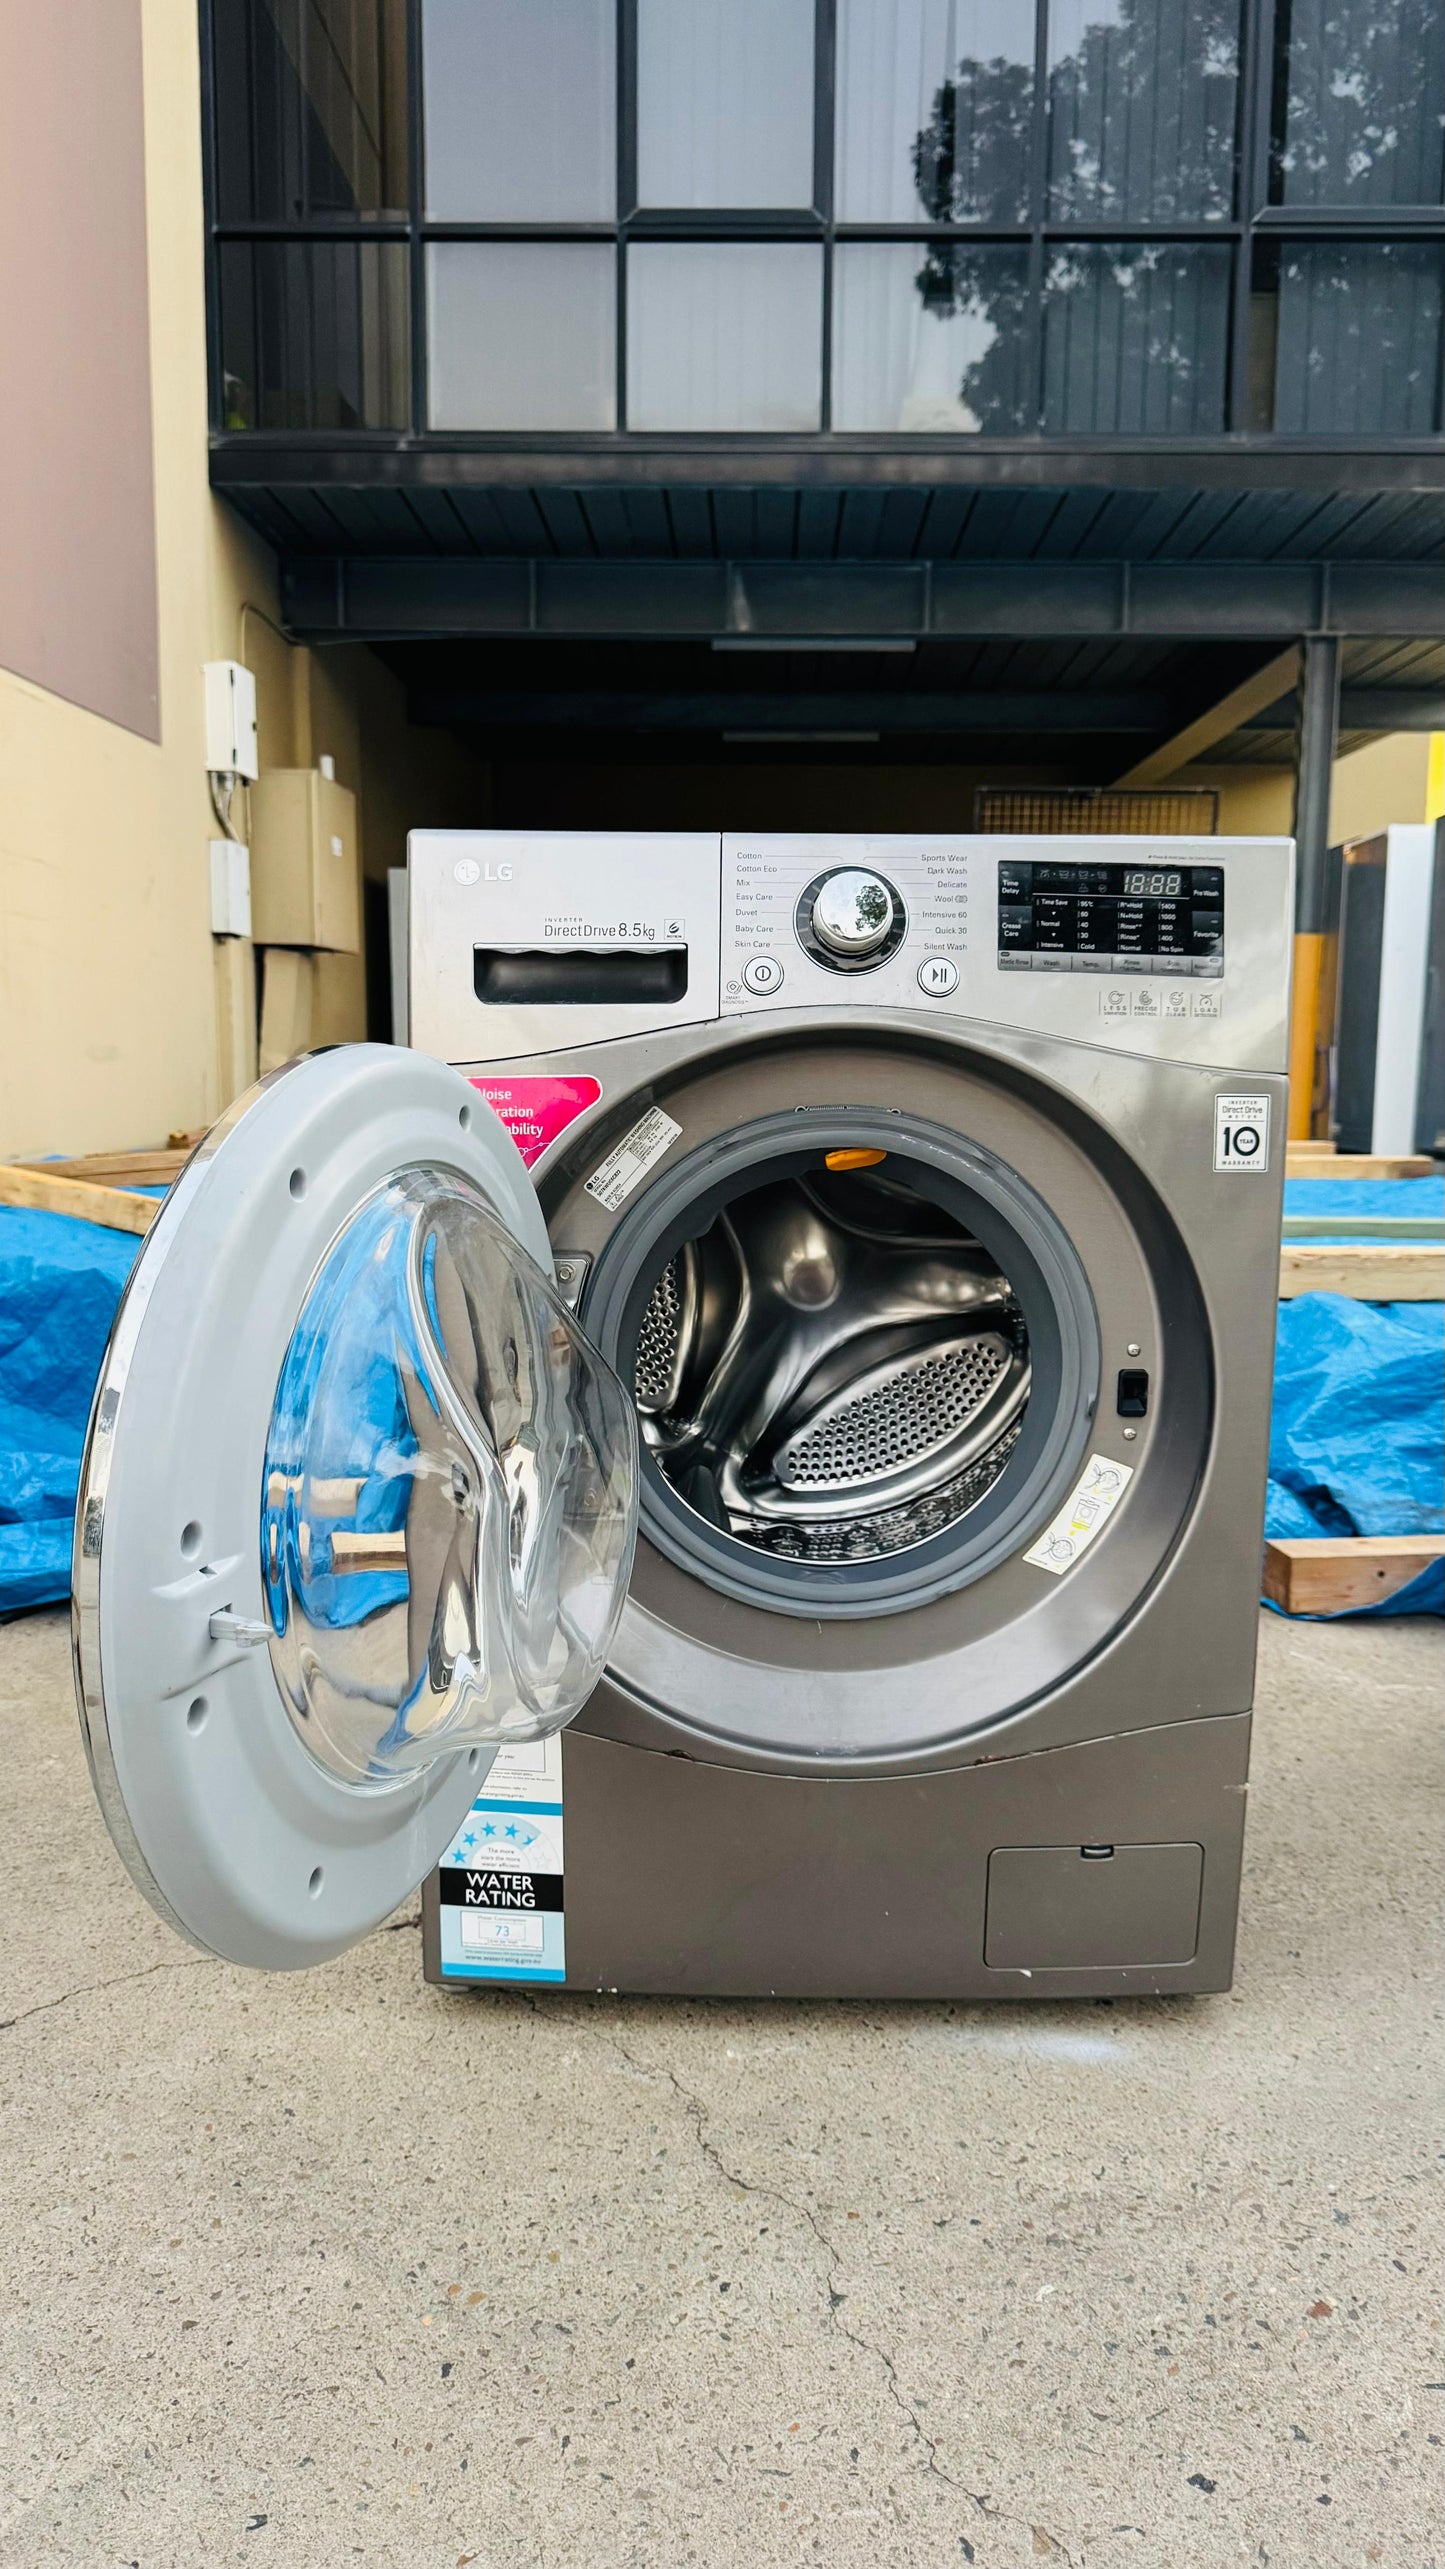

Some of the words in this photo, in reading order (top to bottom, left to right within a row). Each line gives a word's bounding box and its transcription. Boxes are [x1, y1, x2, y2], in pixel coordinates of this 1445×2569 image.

[922, 854, 946, 862] Sports
[948, 854, 968, 862] Wear
[484, 863, 512, 881] LG
[938, 880, 968, 888] Delicate
[736, 892, 753, 901] Easy
[935, 926, 956, 934] Quick
[734, 940, 751, 948] Skin
[753, 940, 770, 948] Care
[924, 942, 944, 950] Silent
[496, 1106, 533, 1118] ration
[1245, 1106, 1263, 1114] Drive
[506, 1123, 544, 1138] ability
[1224, 1126, 1260, 1156] 10
[591, 1175, 600, 1184] LG
[466, 1872, 534, 1891] WATER
[466, 1888, 536, 1908] RATING
[496, 1925, 510, 1937] 73
